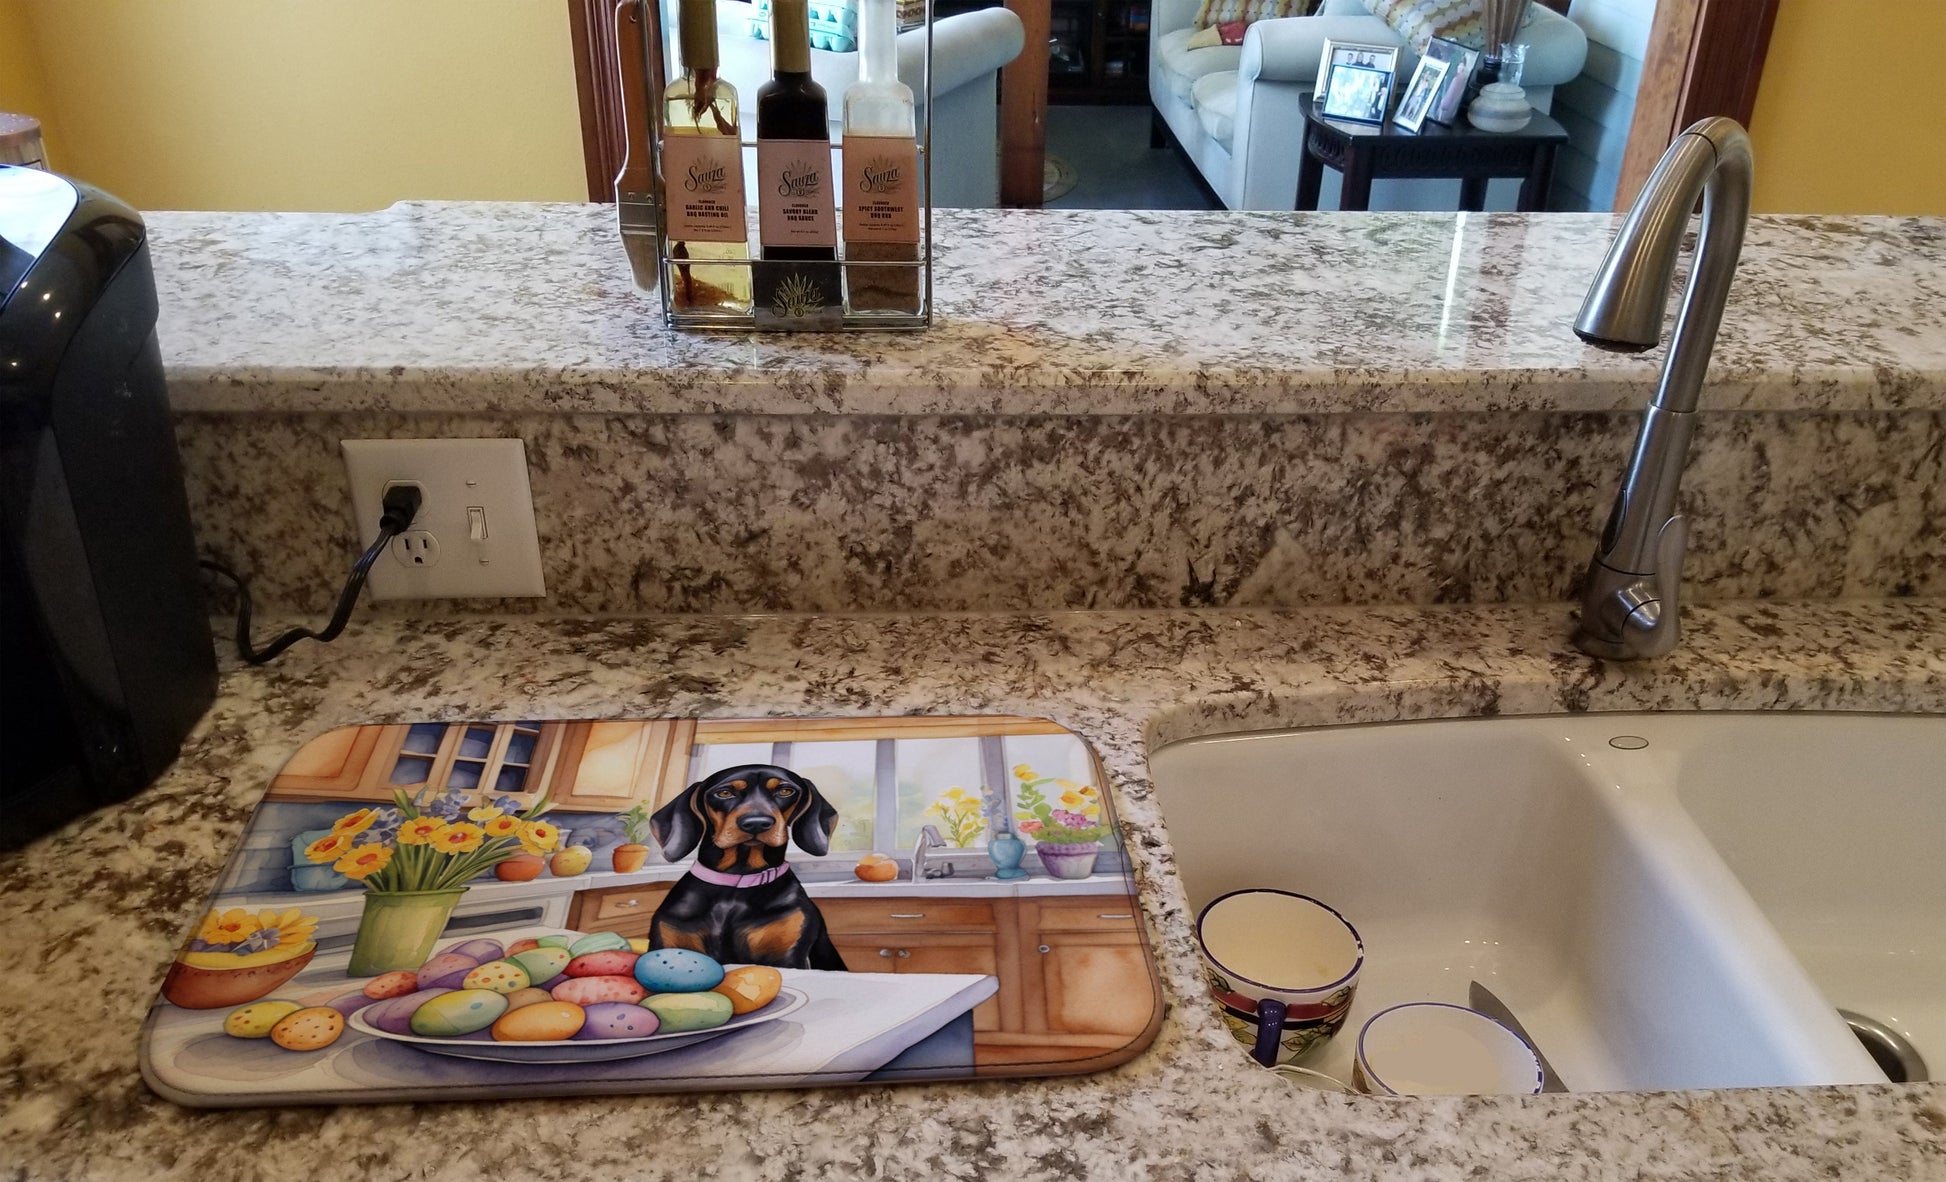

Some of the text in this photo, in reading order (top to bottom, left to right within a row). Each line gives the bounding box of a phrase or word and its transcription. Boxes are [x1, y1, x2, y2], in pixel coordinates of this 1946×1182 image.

[685, 166, 726, 192] Sauza
[778, 171, 819, 197] Sauza
[859, 166, 901, 193] Sauza
